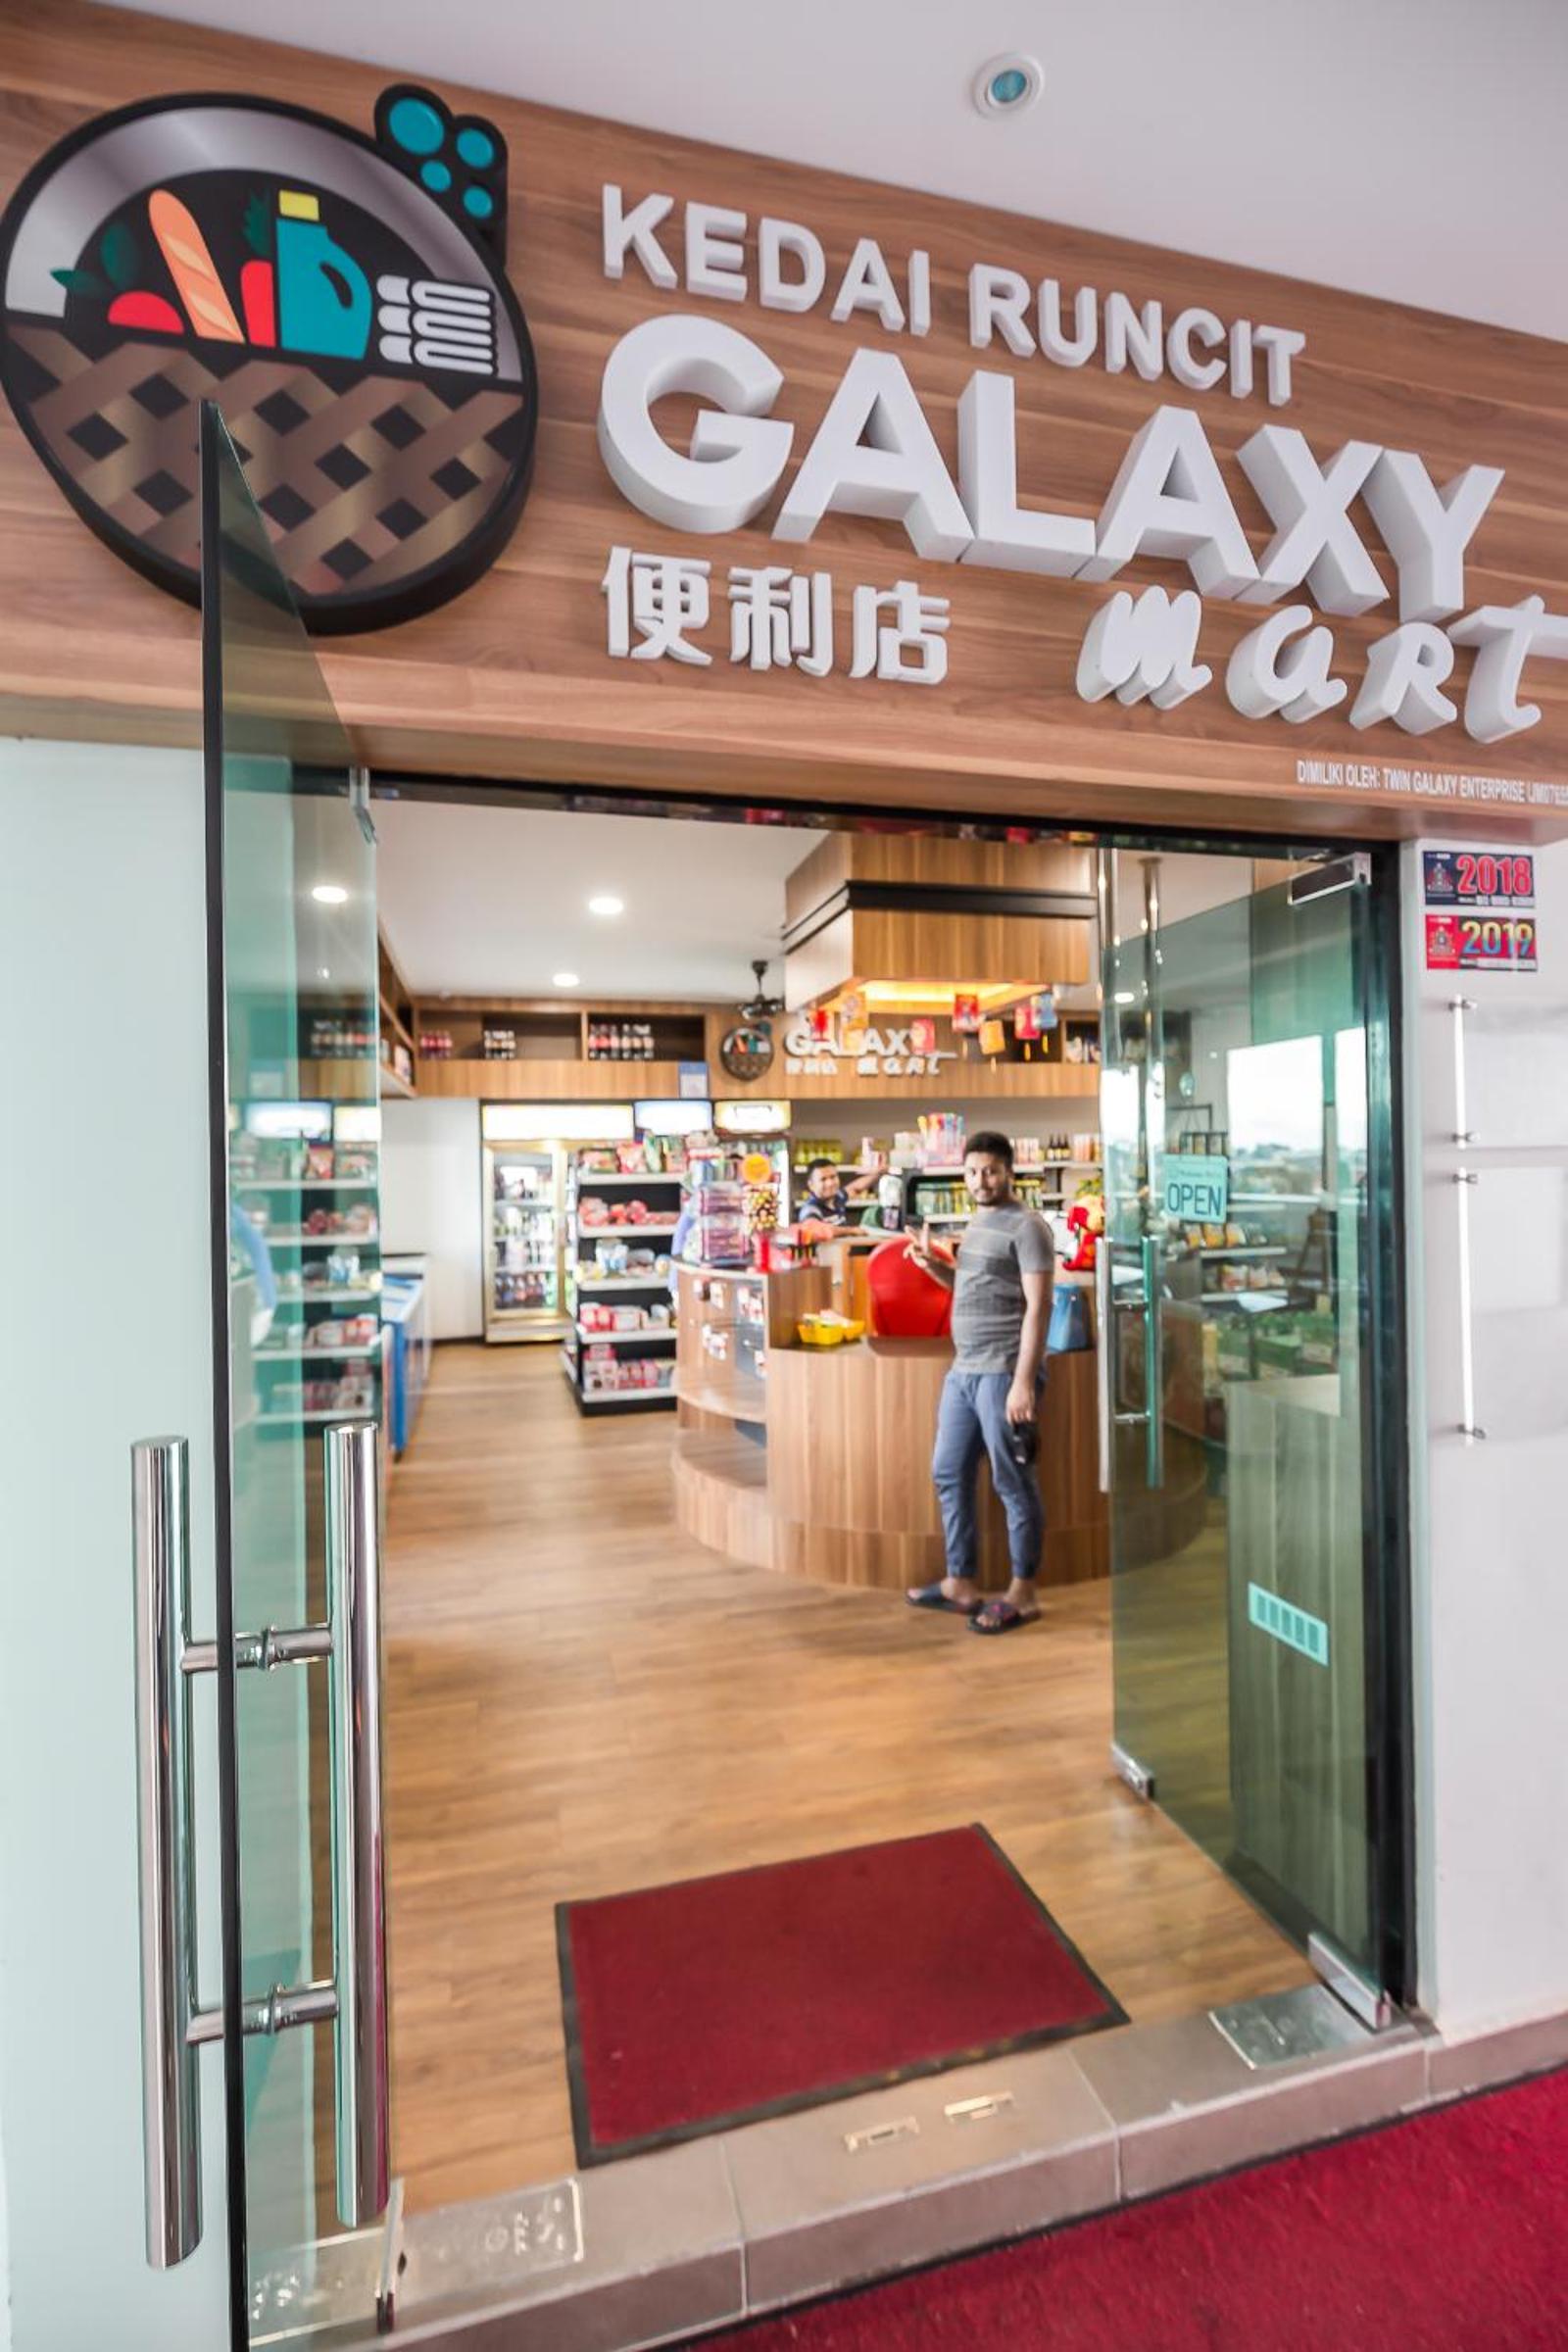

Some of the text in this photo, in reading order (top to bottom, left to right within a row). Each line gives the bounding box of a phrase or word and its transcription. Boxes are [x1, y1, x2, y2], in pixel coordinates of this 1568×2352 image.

[603, 184, 1304, 408] KEDAI RUNCIT
[598, 314, 1504, 623] GALAXY
[601, 546, 950, 686] 便利店
[1297, 760, 1344, 785] DIMILIKI
[1346, 763, 1381, 789] OLEH:
[1383, 767, 1411, 792] TWIN
[1413, 771, 1457, 797] GALAXY
[1459, 775, 1526, 803] ENTERPRISE
[1456, 854, 1532, 896] 2018
[1461, 920, 1534, 956] 2019
[785, 1027, 932, 1057] GAAX
[1167, 1182, 1223, 1217] OPEN
